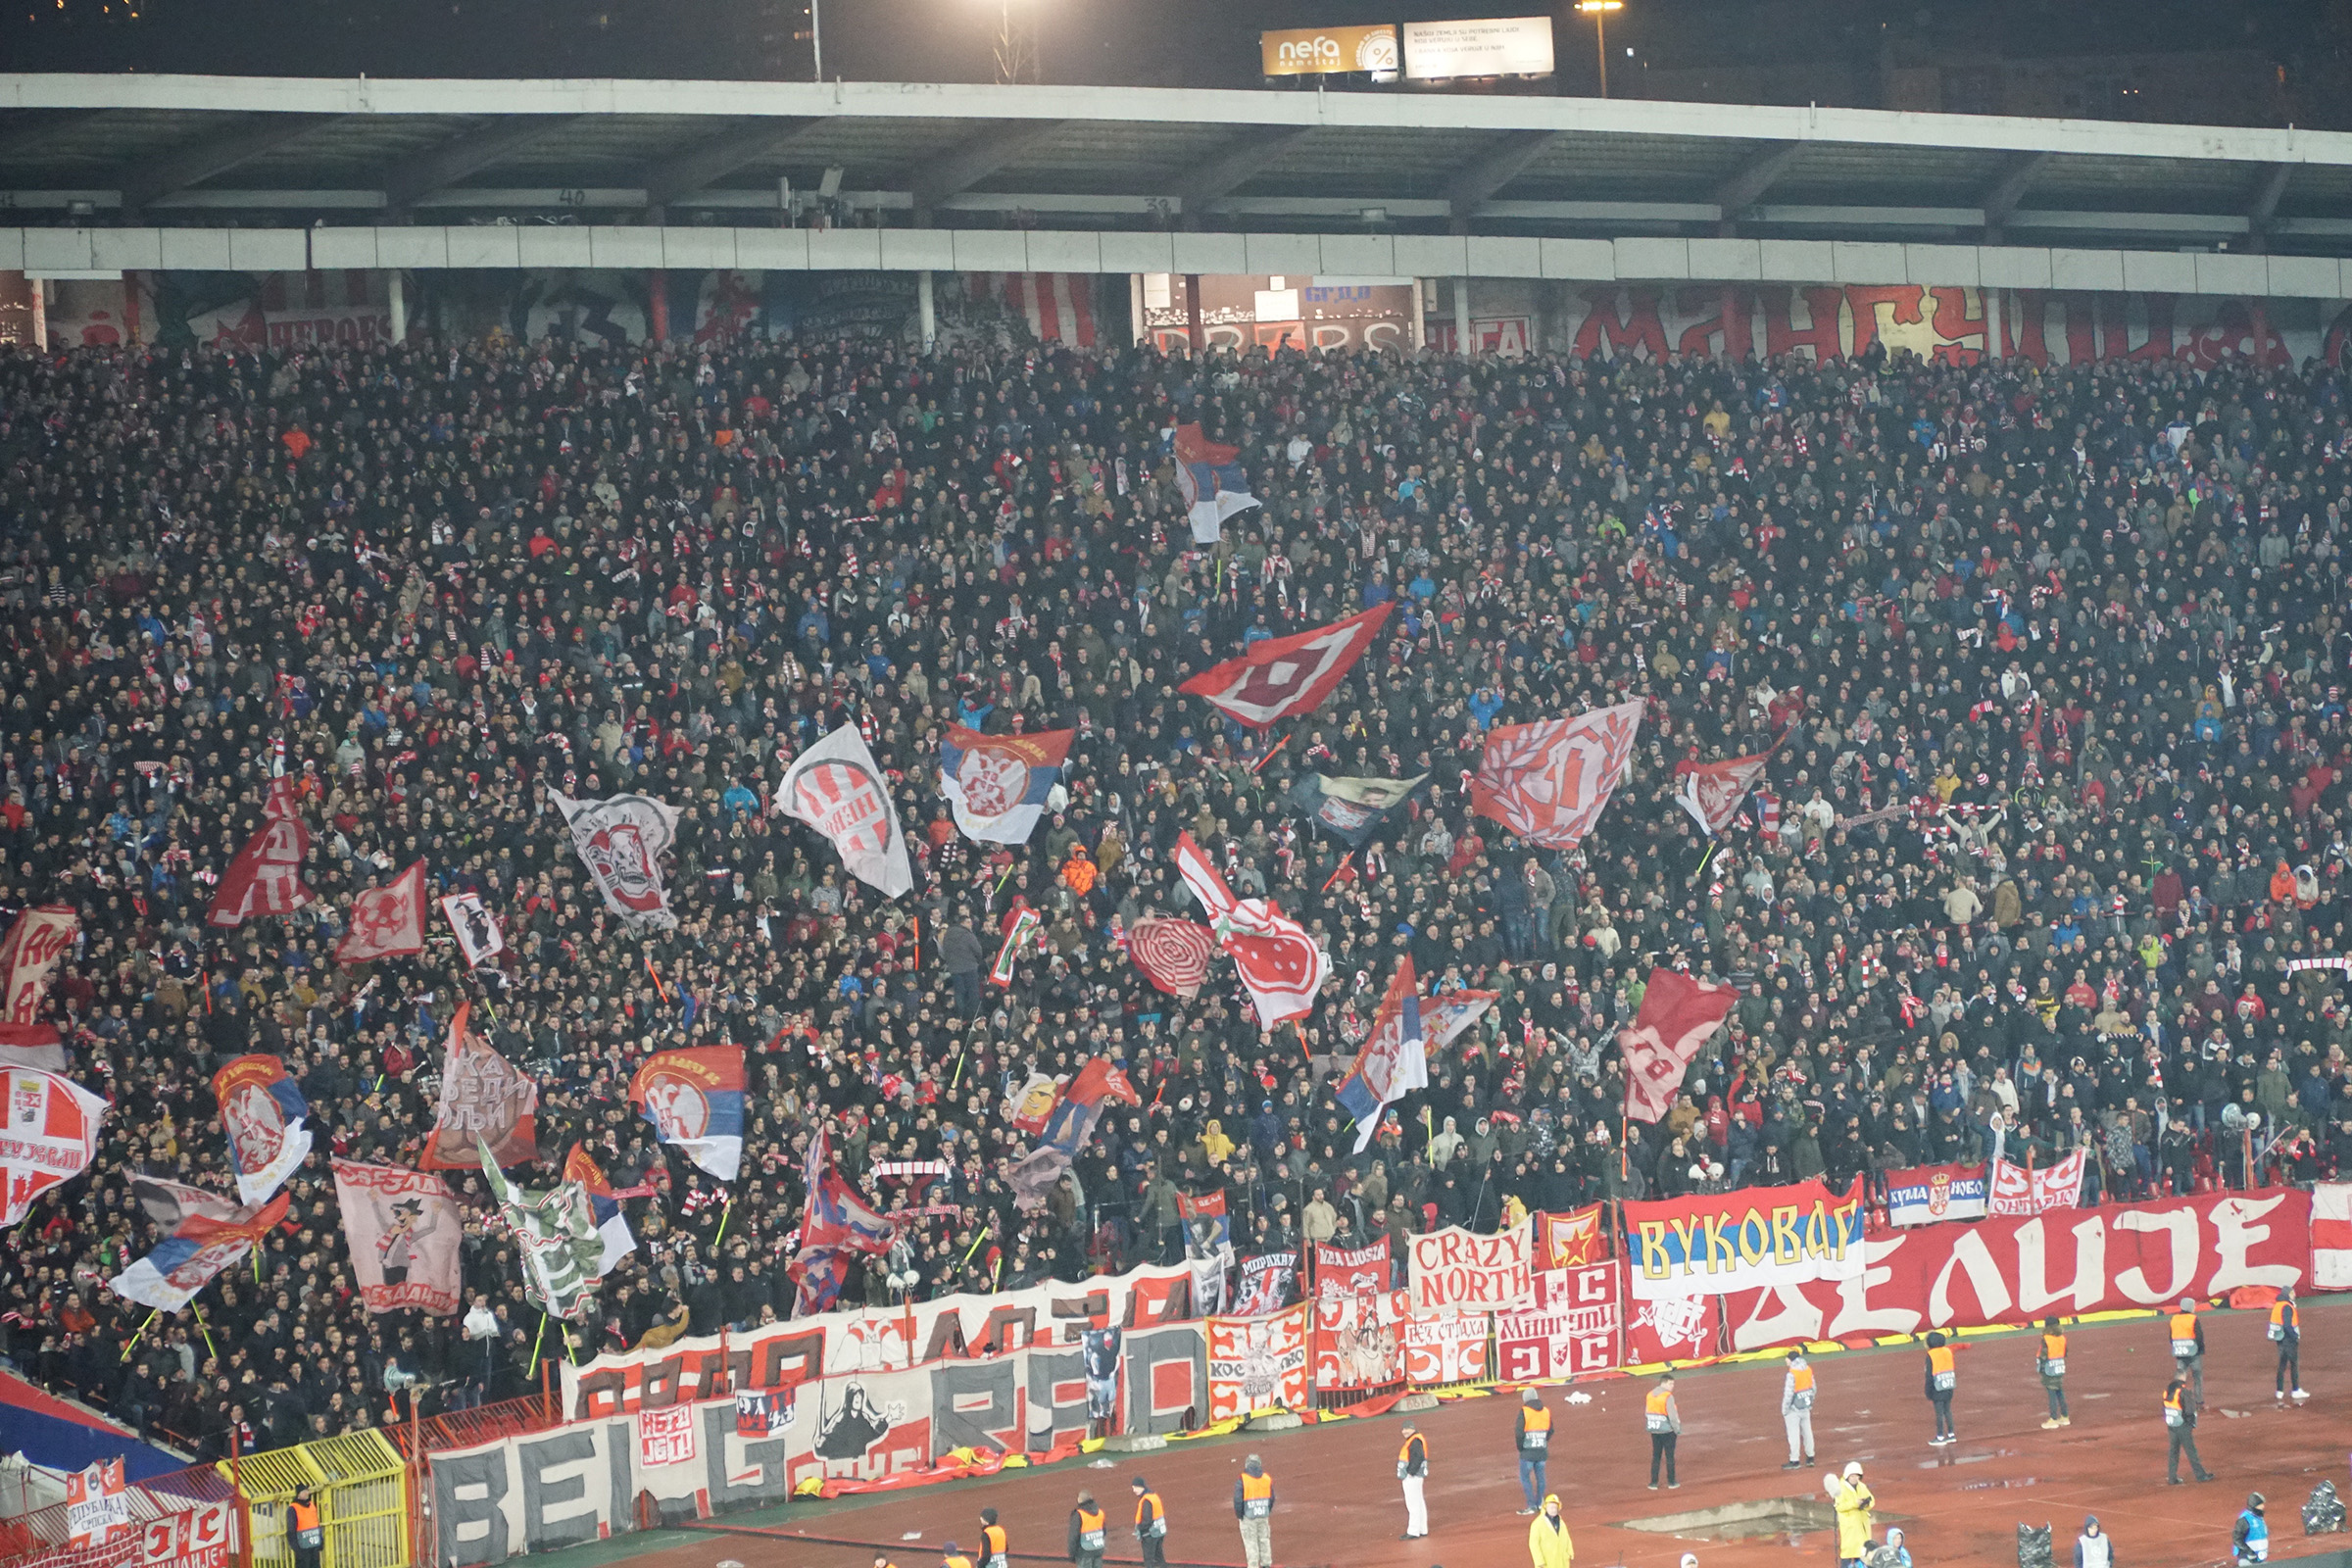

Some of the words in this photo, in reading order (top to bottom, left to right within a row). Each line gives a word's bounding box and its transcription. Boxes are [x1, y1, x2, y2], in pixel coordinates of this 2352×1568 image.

[1279, 35, 1340, 59] nefa
[1279, 58, 1341, 67] nameštaj
[560, 188, 584, 205] 40
[1415, 1227, 1526, 1271] CRAZY
[1638, 1197, 1858, 1280] ВУКОВАР
[1344, 1243, 1386, 1267] LIOSIA
[1421, 1260, 1532, 1308] NORTH
